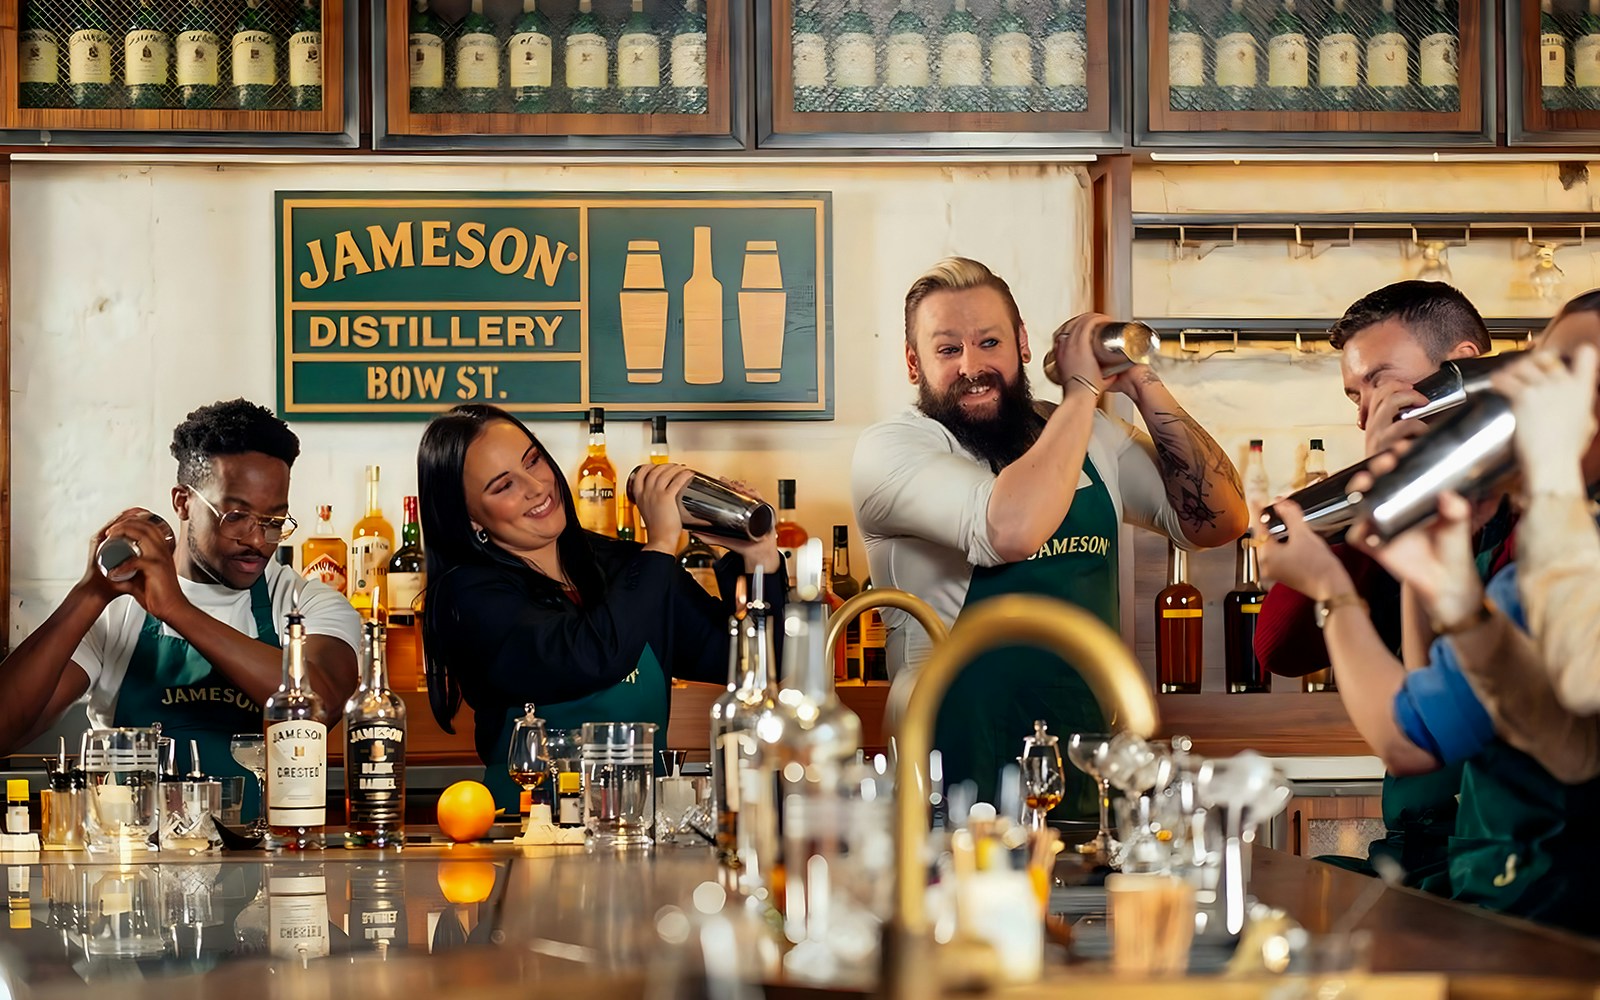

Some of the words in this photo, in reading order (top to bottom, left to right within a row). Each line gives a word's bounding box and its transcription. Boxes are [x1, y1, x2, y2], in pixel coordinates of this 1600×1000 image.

[299, 220, 567, 289] JAMESON
[308, 314, 562, 347] DISTILLERY
[367, 366, 445, 401] BOW
[456, 366, 508, 400] ST.
